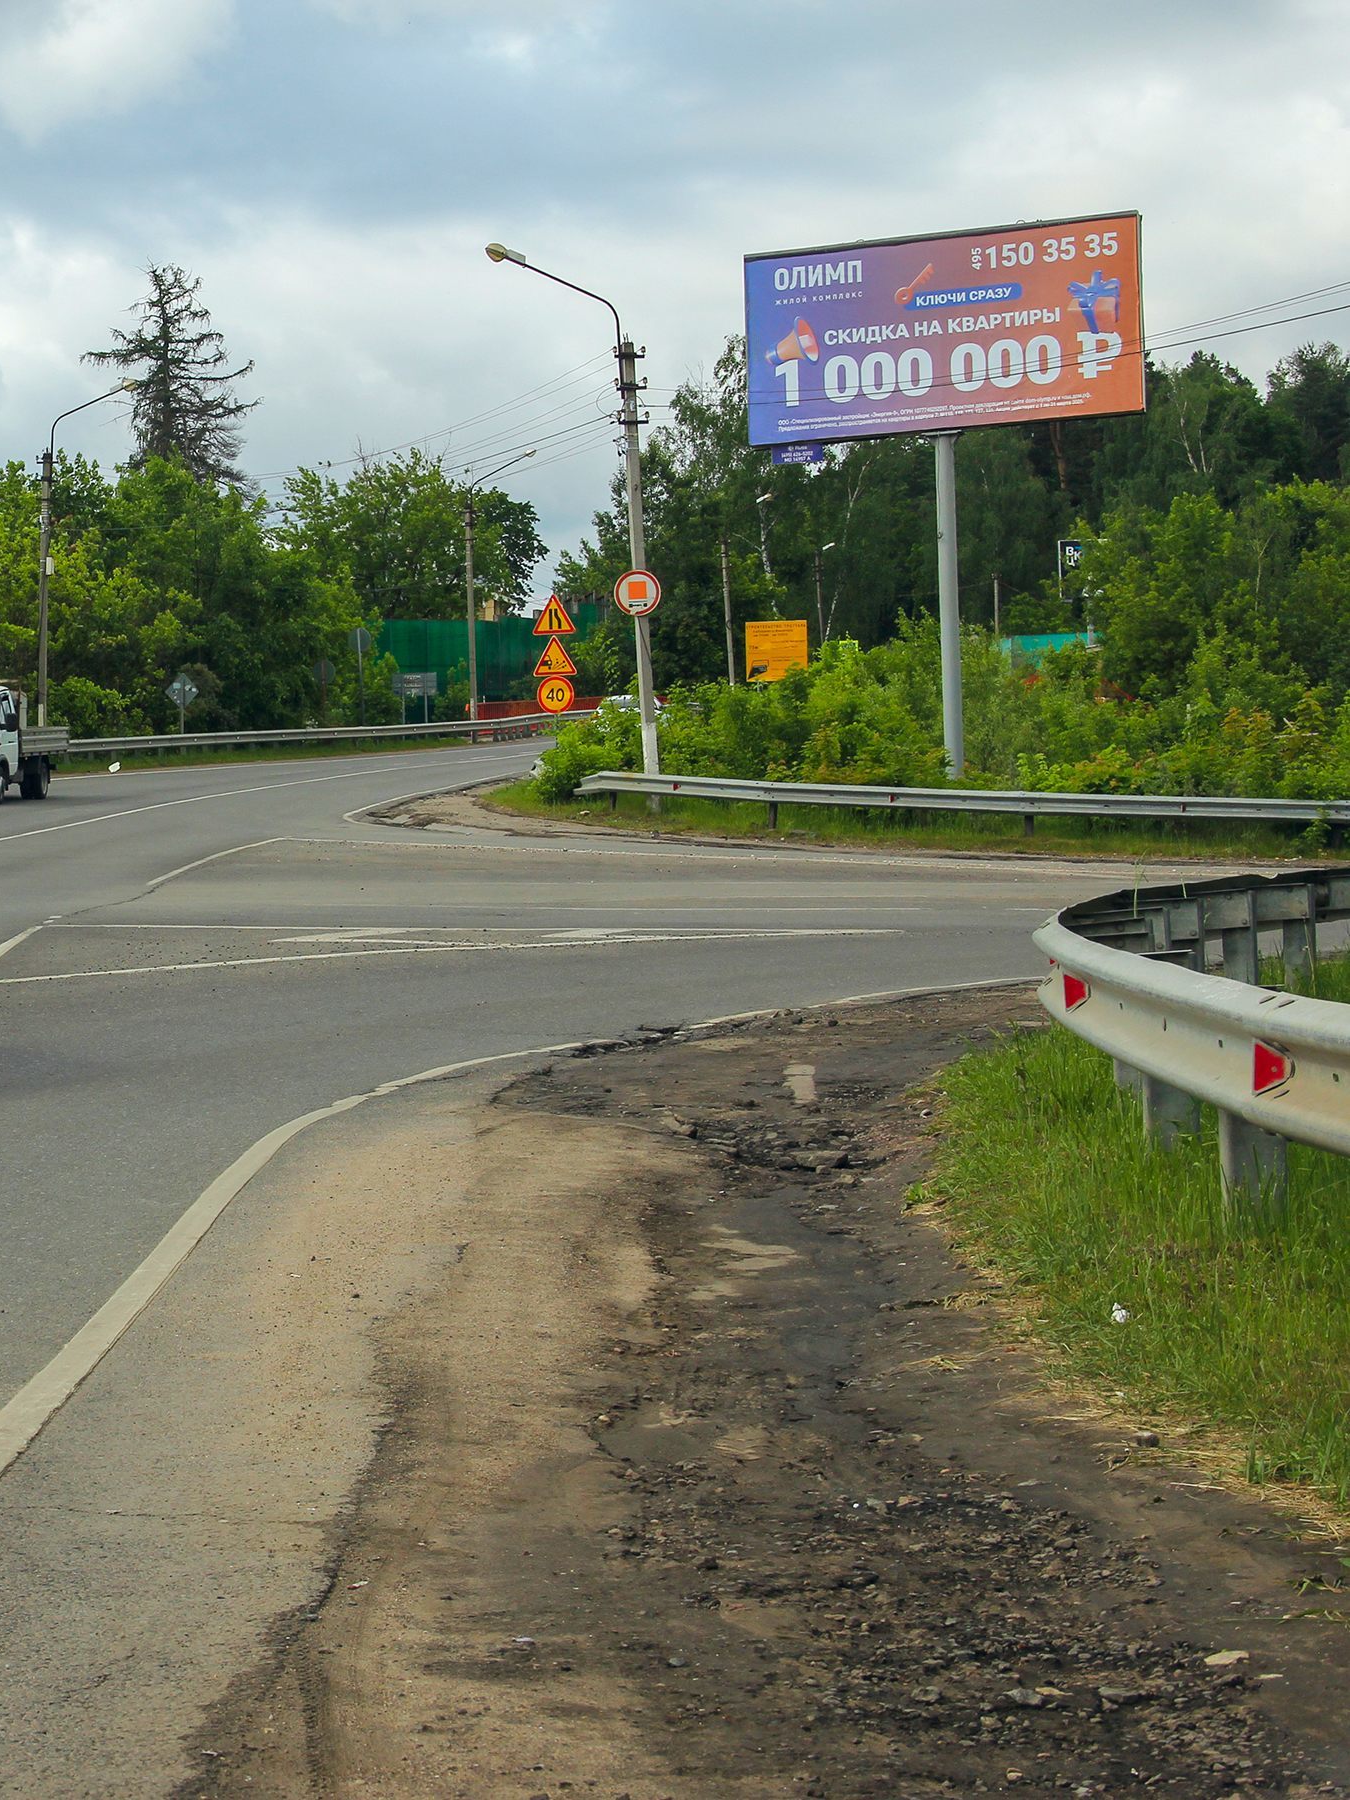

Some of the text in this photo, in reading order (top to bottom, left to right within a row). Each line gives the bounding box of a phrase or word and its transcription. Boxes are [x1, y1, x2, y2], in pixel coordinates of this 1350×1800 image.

[971, 231, 1119, 270] 495 150 35 35
[774, 260, 863, 291] ОЛИМП
[915, 287, 1012, 307] КЛЮЧИ СРАЗУ
[824, 307, 1061, 346] СКИДКА НА КВАРТИРЫ
[775, 360, 799, 407] 1
[823, 347, 933, 404] 000
[950, 334, 1062, 393] 000
[546, 687, 565, 702] 40
